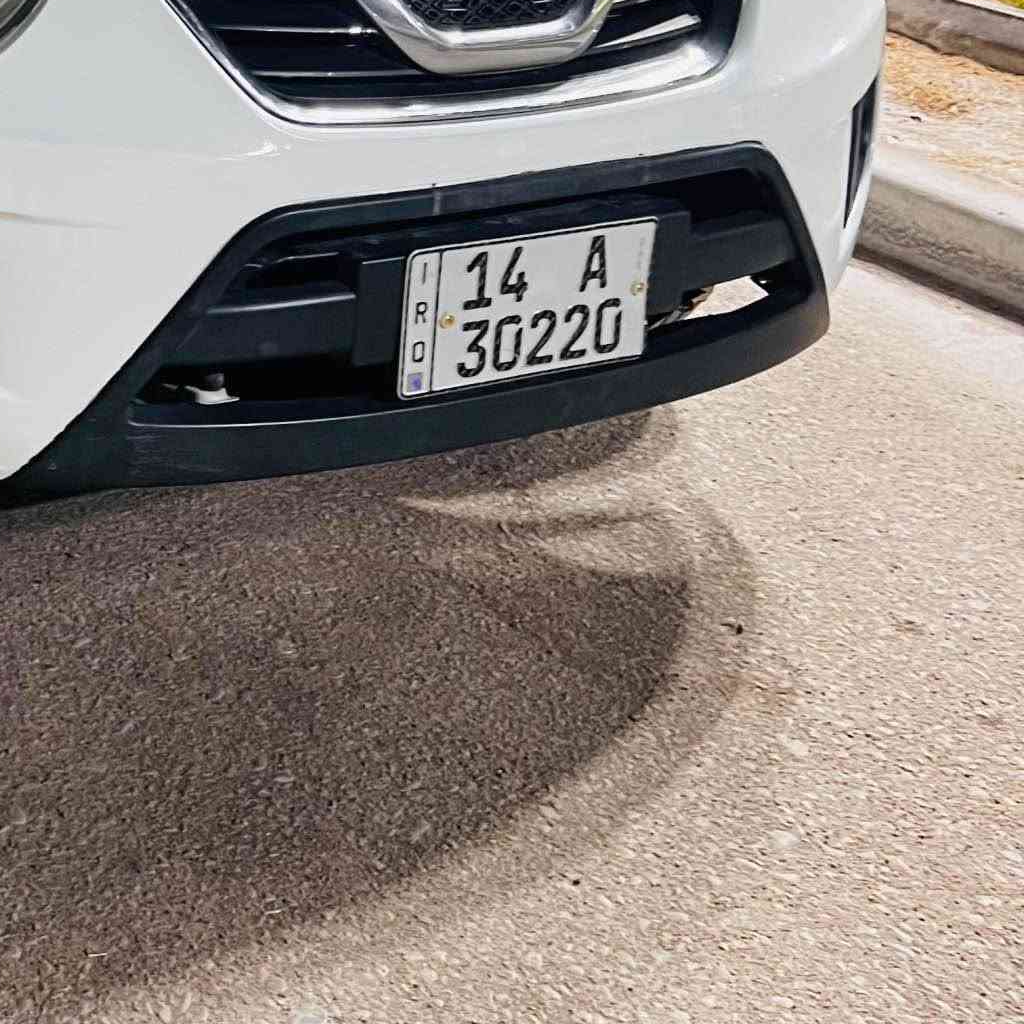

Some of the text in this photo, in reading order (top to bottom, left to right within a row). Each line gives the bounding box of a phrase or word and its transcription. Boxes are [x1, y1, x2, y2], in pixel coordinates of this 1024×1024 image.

[463, 246, 528, 310] 14
[579, 235, 607, 293] A
[456, 297, 623, 378] 30220
